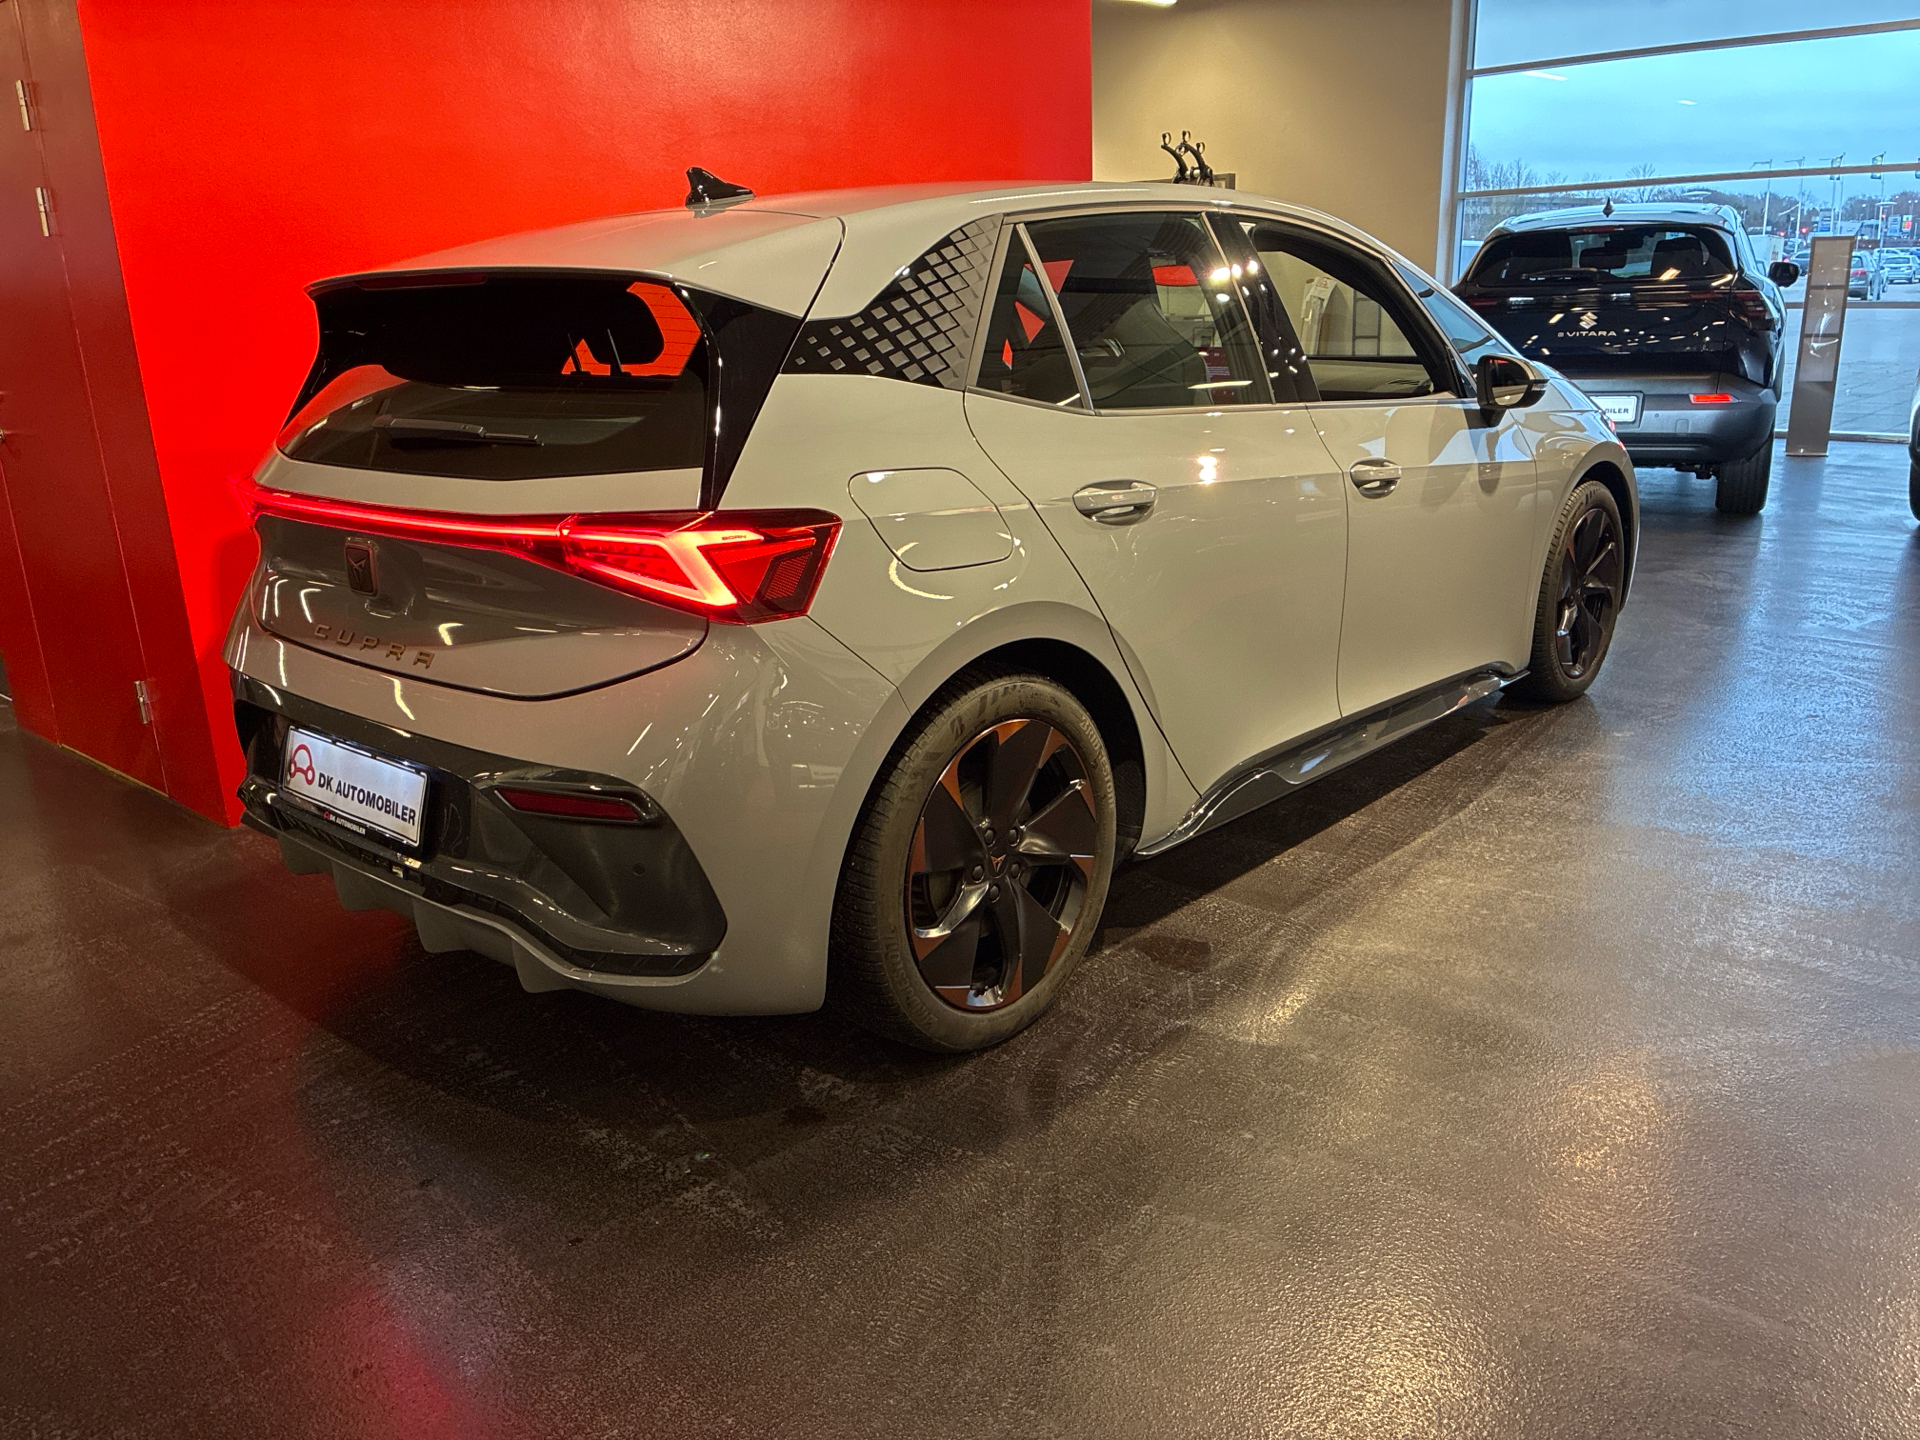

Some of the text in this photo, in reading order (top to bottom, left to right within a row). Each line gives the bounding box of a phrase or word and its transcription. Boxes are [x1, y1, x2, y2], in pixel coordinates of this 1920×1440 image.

[314, 624, 435, 669] CUPRA
[318, 772, 416, 826] DK AUTOMOBILER
